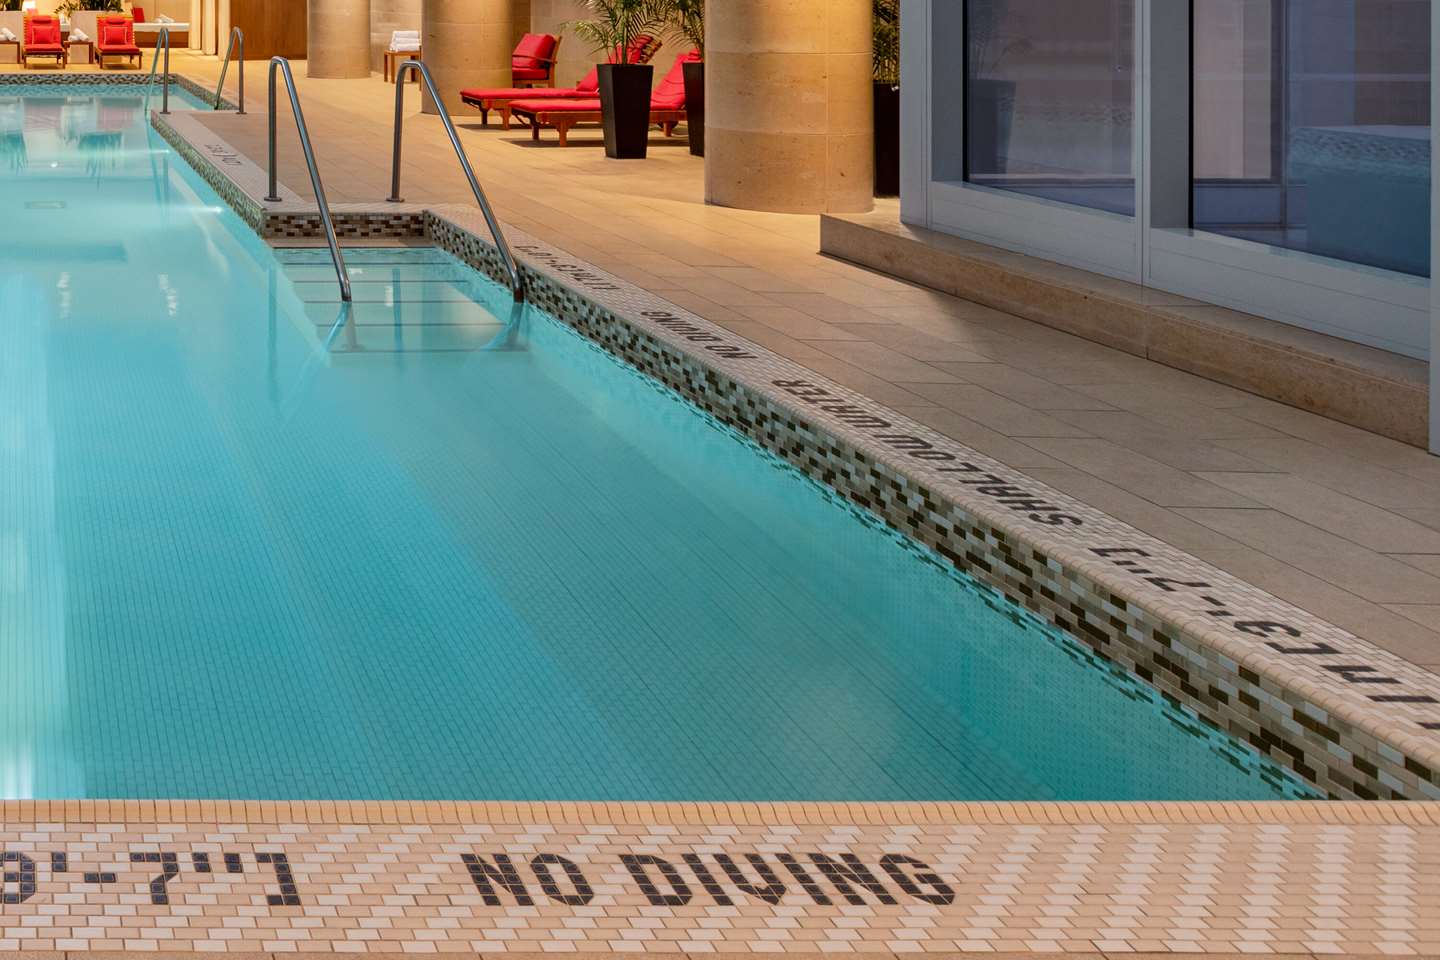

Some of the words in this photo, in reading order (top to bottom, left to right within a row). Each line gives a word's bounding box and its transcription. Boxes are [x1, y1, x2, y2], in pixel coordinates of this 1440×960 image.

[641, 310, 723, 342] DIVING
[704, 344, 757, 360] NO
[771, 379, 892, 429] WATER
[874, 434, 1082, 526] SHALLOW
[459, 853, 595, 907] NO
[618, 853, 956, 907] DIVING
